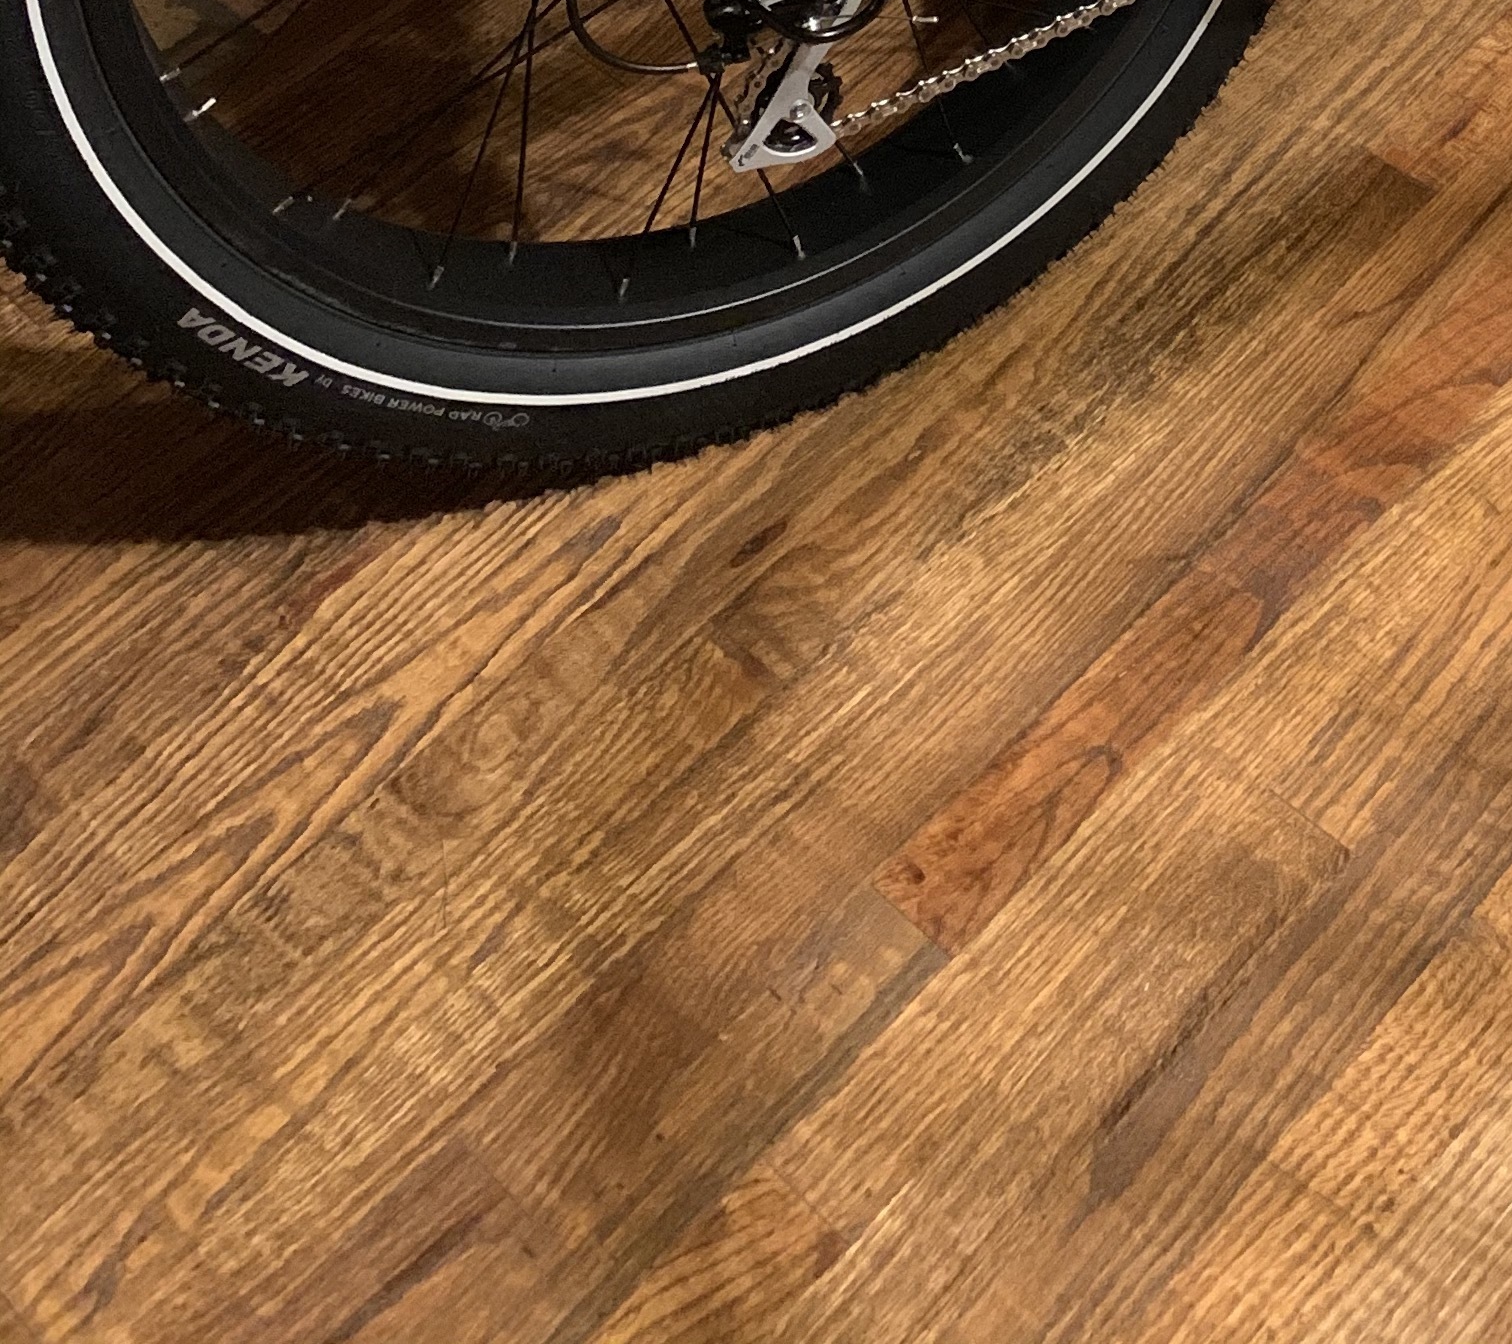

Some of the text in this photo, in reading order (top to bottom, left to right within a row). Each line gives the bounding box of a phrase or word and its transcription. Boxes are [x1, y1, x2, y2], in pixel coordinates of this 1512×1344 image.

[176, 307, 309, 387] KENDA
[340, 384, 386, 405] BIKES
[387, 397, 446, 417] POWER
[448, 410, 482, 421] RAD
